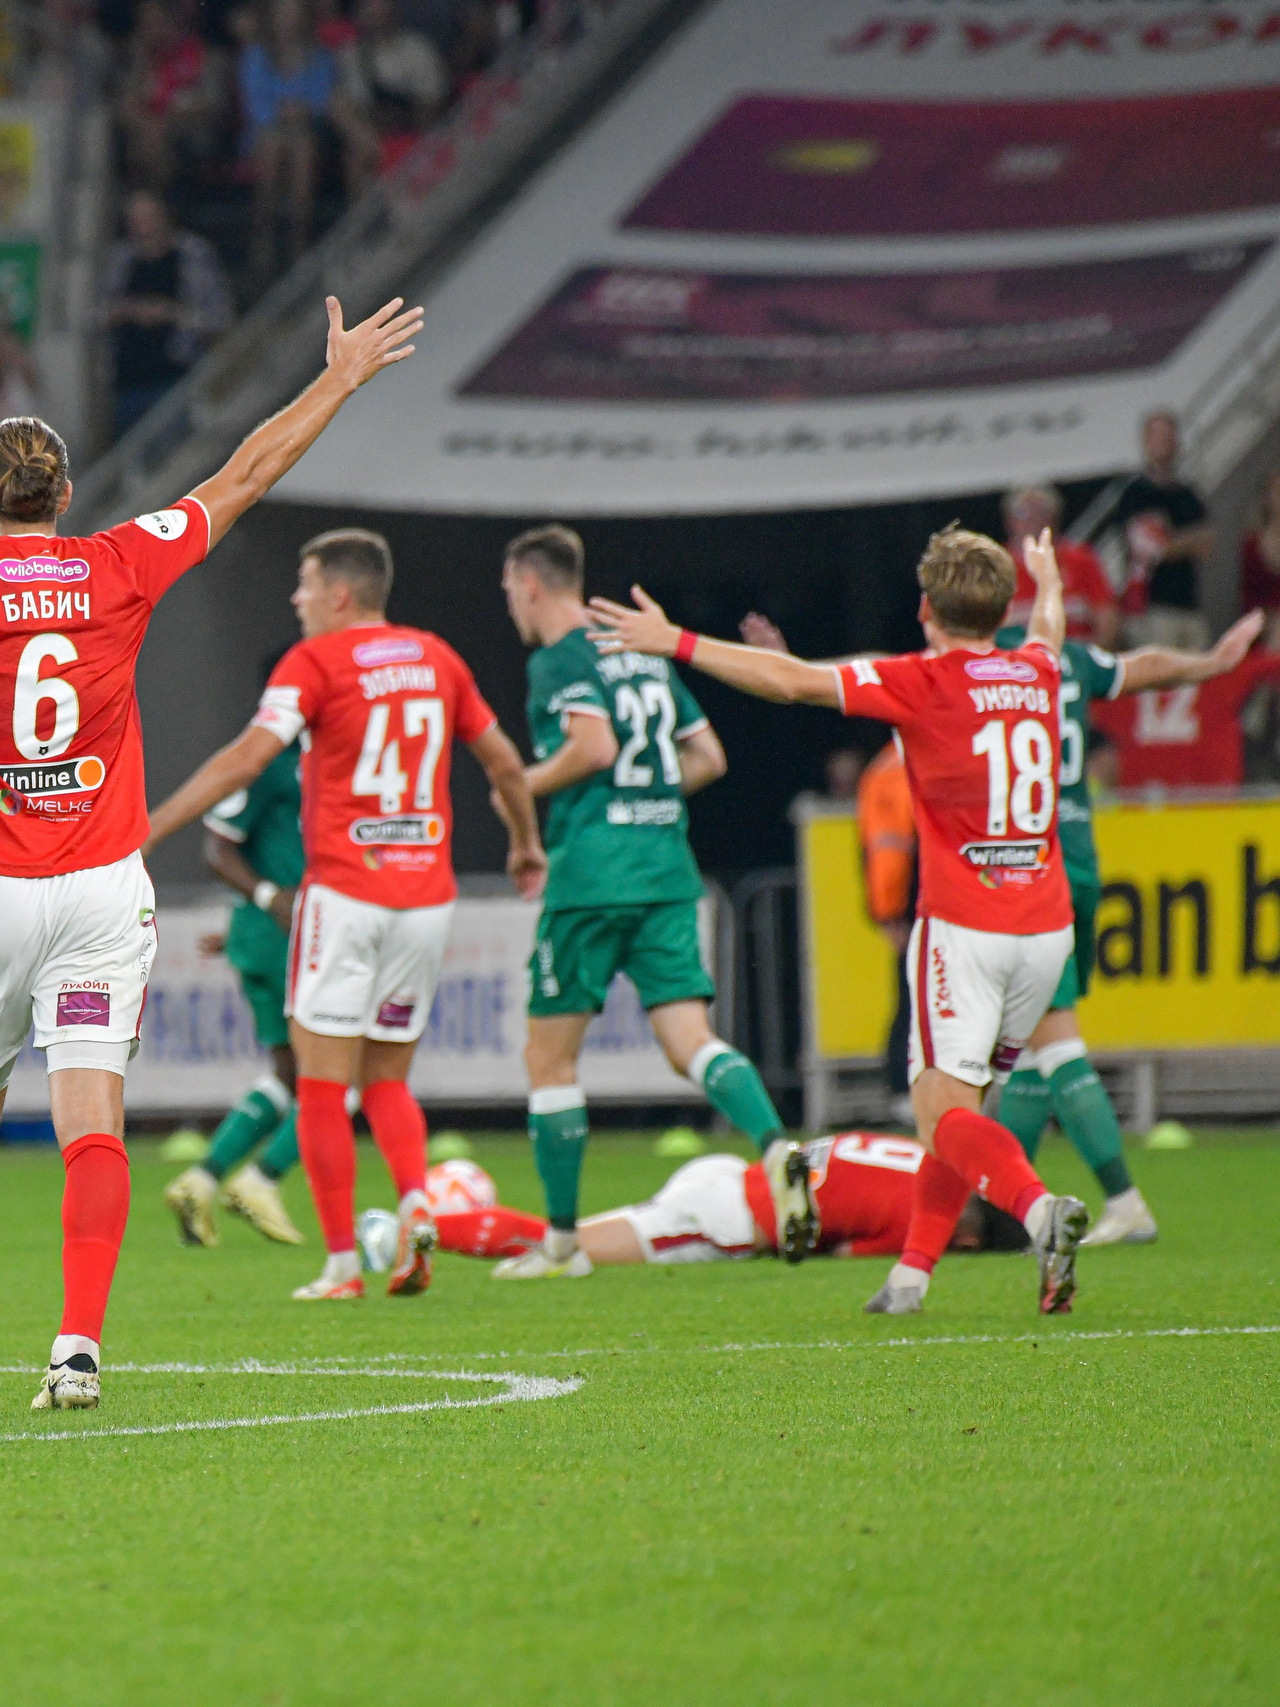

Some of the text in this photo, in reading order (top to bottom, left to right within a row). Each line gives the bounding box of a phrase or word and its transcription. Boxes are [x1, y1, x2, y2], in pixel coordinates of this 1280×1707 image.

[830, 12, 1280, 57] ЛУКО
[4, 561, 83, 578] wildberries
[1, 590, 90, 622] БАБИЧ
[12, 632, 80, 760] 6
[968, 684, 1050, 714] УМЯРОВ
[614, 681, 681, 787] 27
[352, 698, 444, 814] 47
[972, 718, 1055, 836] 18
[26, 798, 93, 813] MELKE
[60, 979, 109, 990] ЛУКОЙЛ
